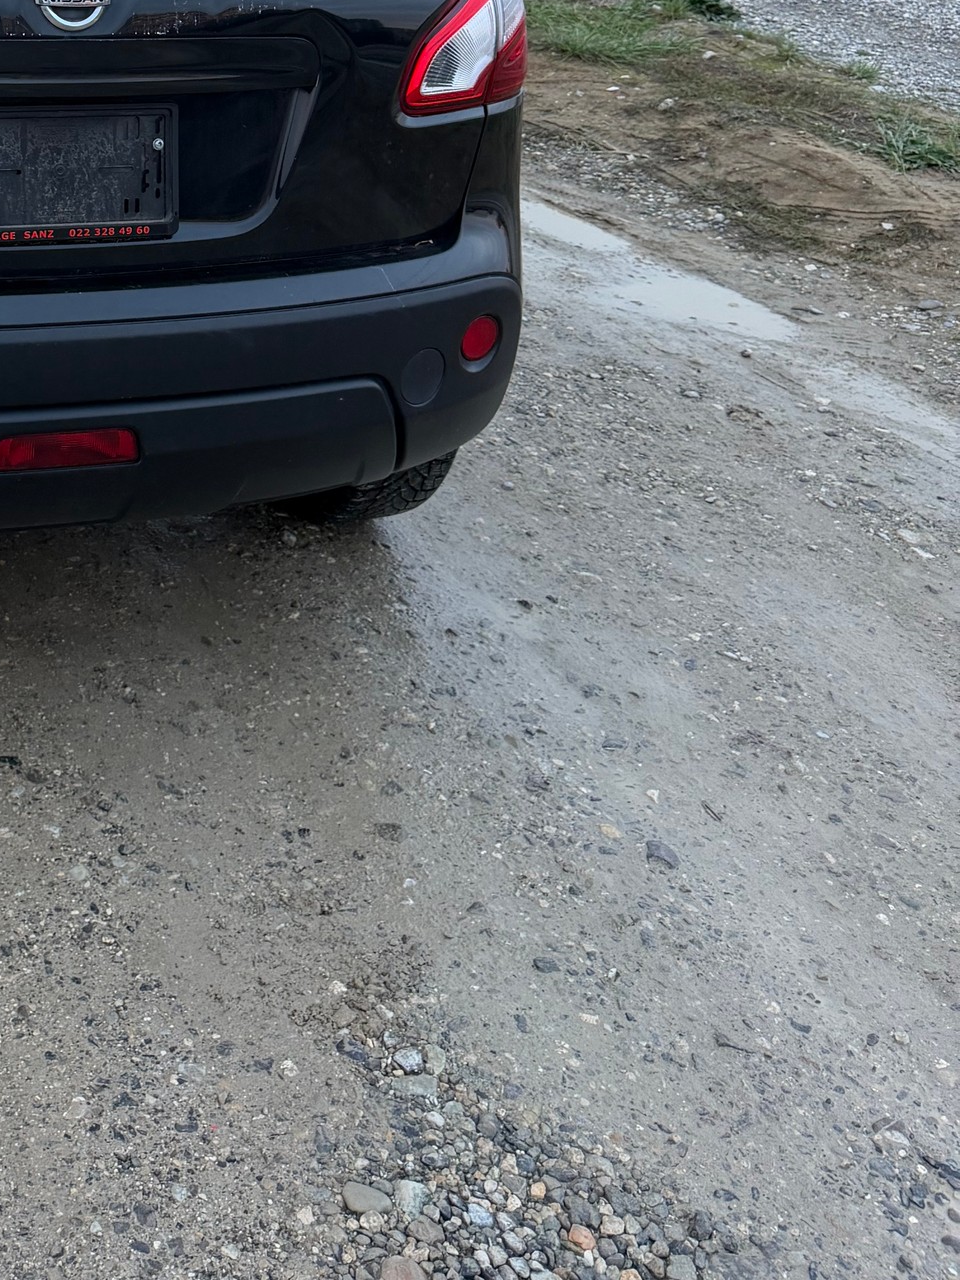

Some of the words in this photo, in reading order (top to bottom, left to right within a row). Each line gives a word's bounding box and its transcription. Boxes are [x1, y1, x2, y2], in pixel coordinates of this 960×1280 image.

[23, 229, 54, 240] SANZ
[69, 228, 91, 238] 022
[94, 227, 115, 236] 328
[119, 226, 133, 235] 49
[136, 225, 150, 235] 60
